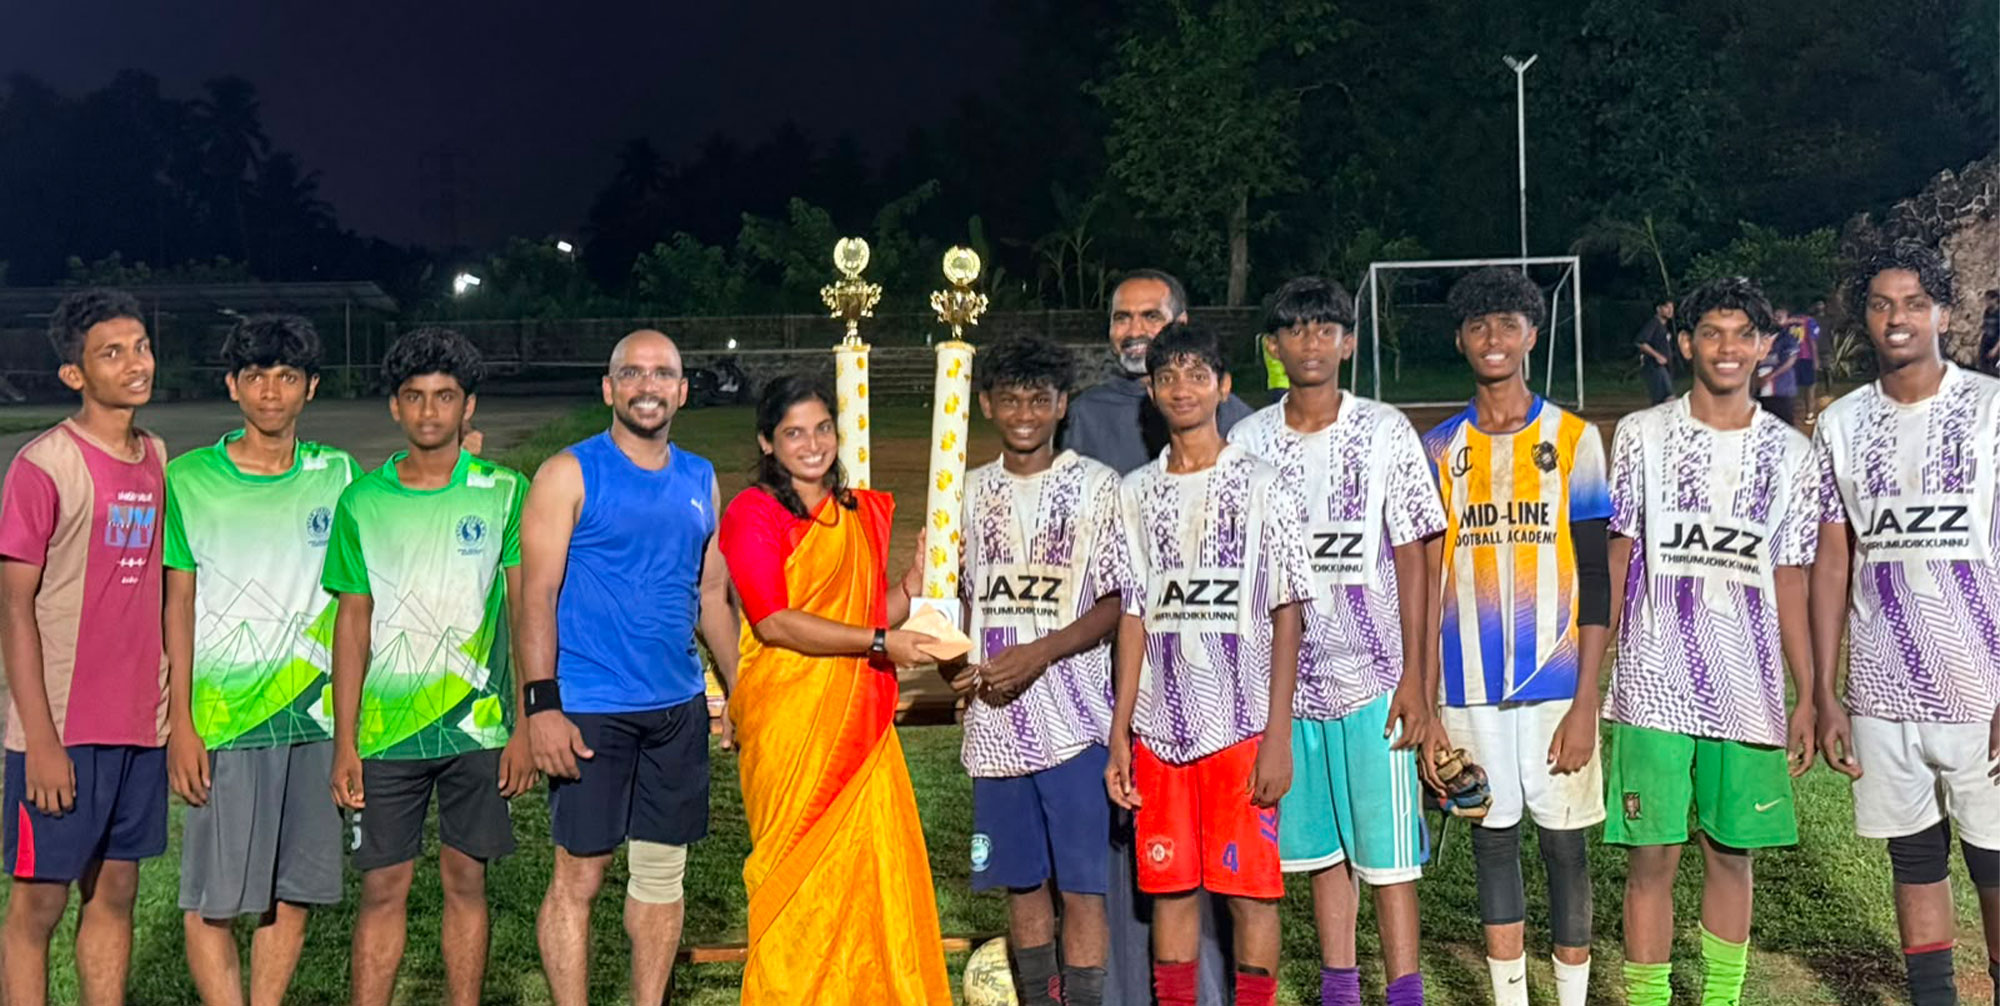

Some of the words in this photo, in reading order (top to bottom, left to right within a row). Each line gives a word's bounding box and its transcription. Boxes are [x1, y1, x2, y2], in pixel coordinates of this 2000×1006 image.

[1460, 501, 1549, 528] MID-LINE
[1861, 505, 1969, 536] JAZZ
[1306, 533, 1363, 559] ZZ
[1456, 531, 1503, 547] OOTBALL
[1660, 523, 1763, 559] JAZZ
[1312, 563, 1363, 573] DIKKUNNU
[979, 575, 1062, 602] JAZZ
[1158, 579, 1239, 606] AZZ
[1222, 843, 1239, 873] 4
